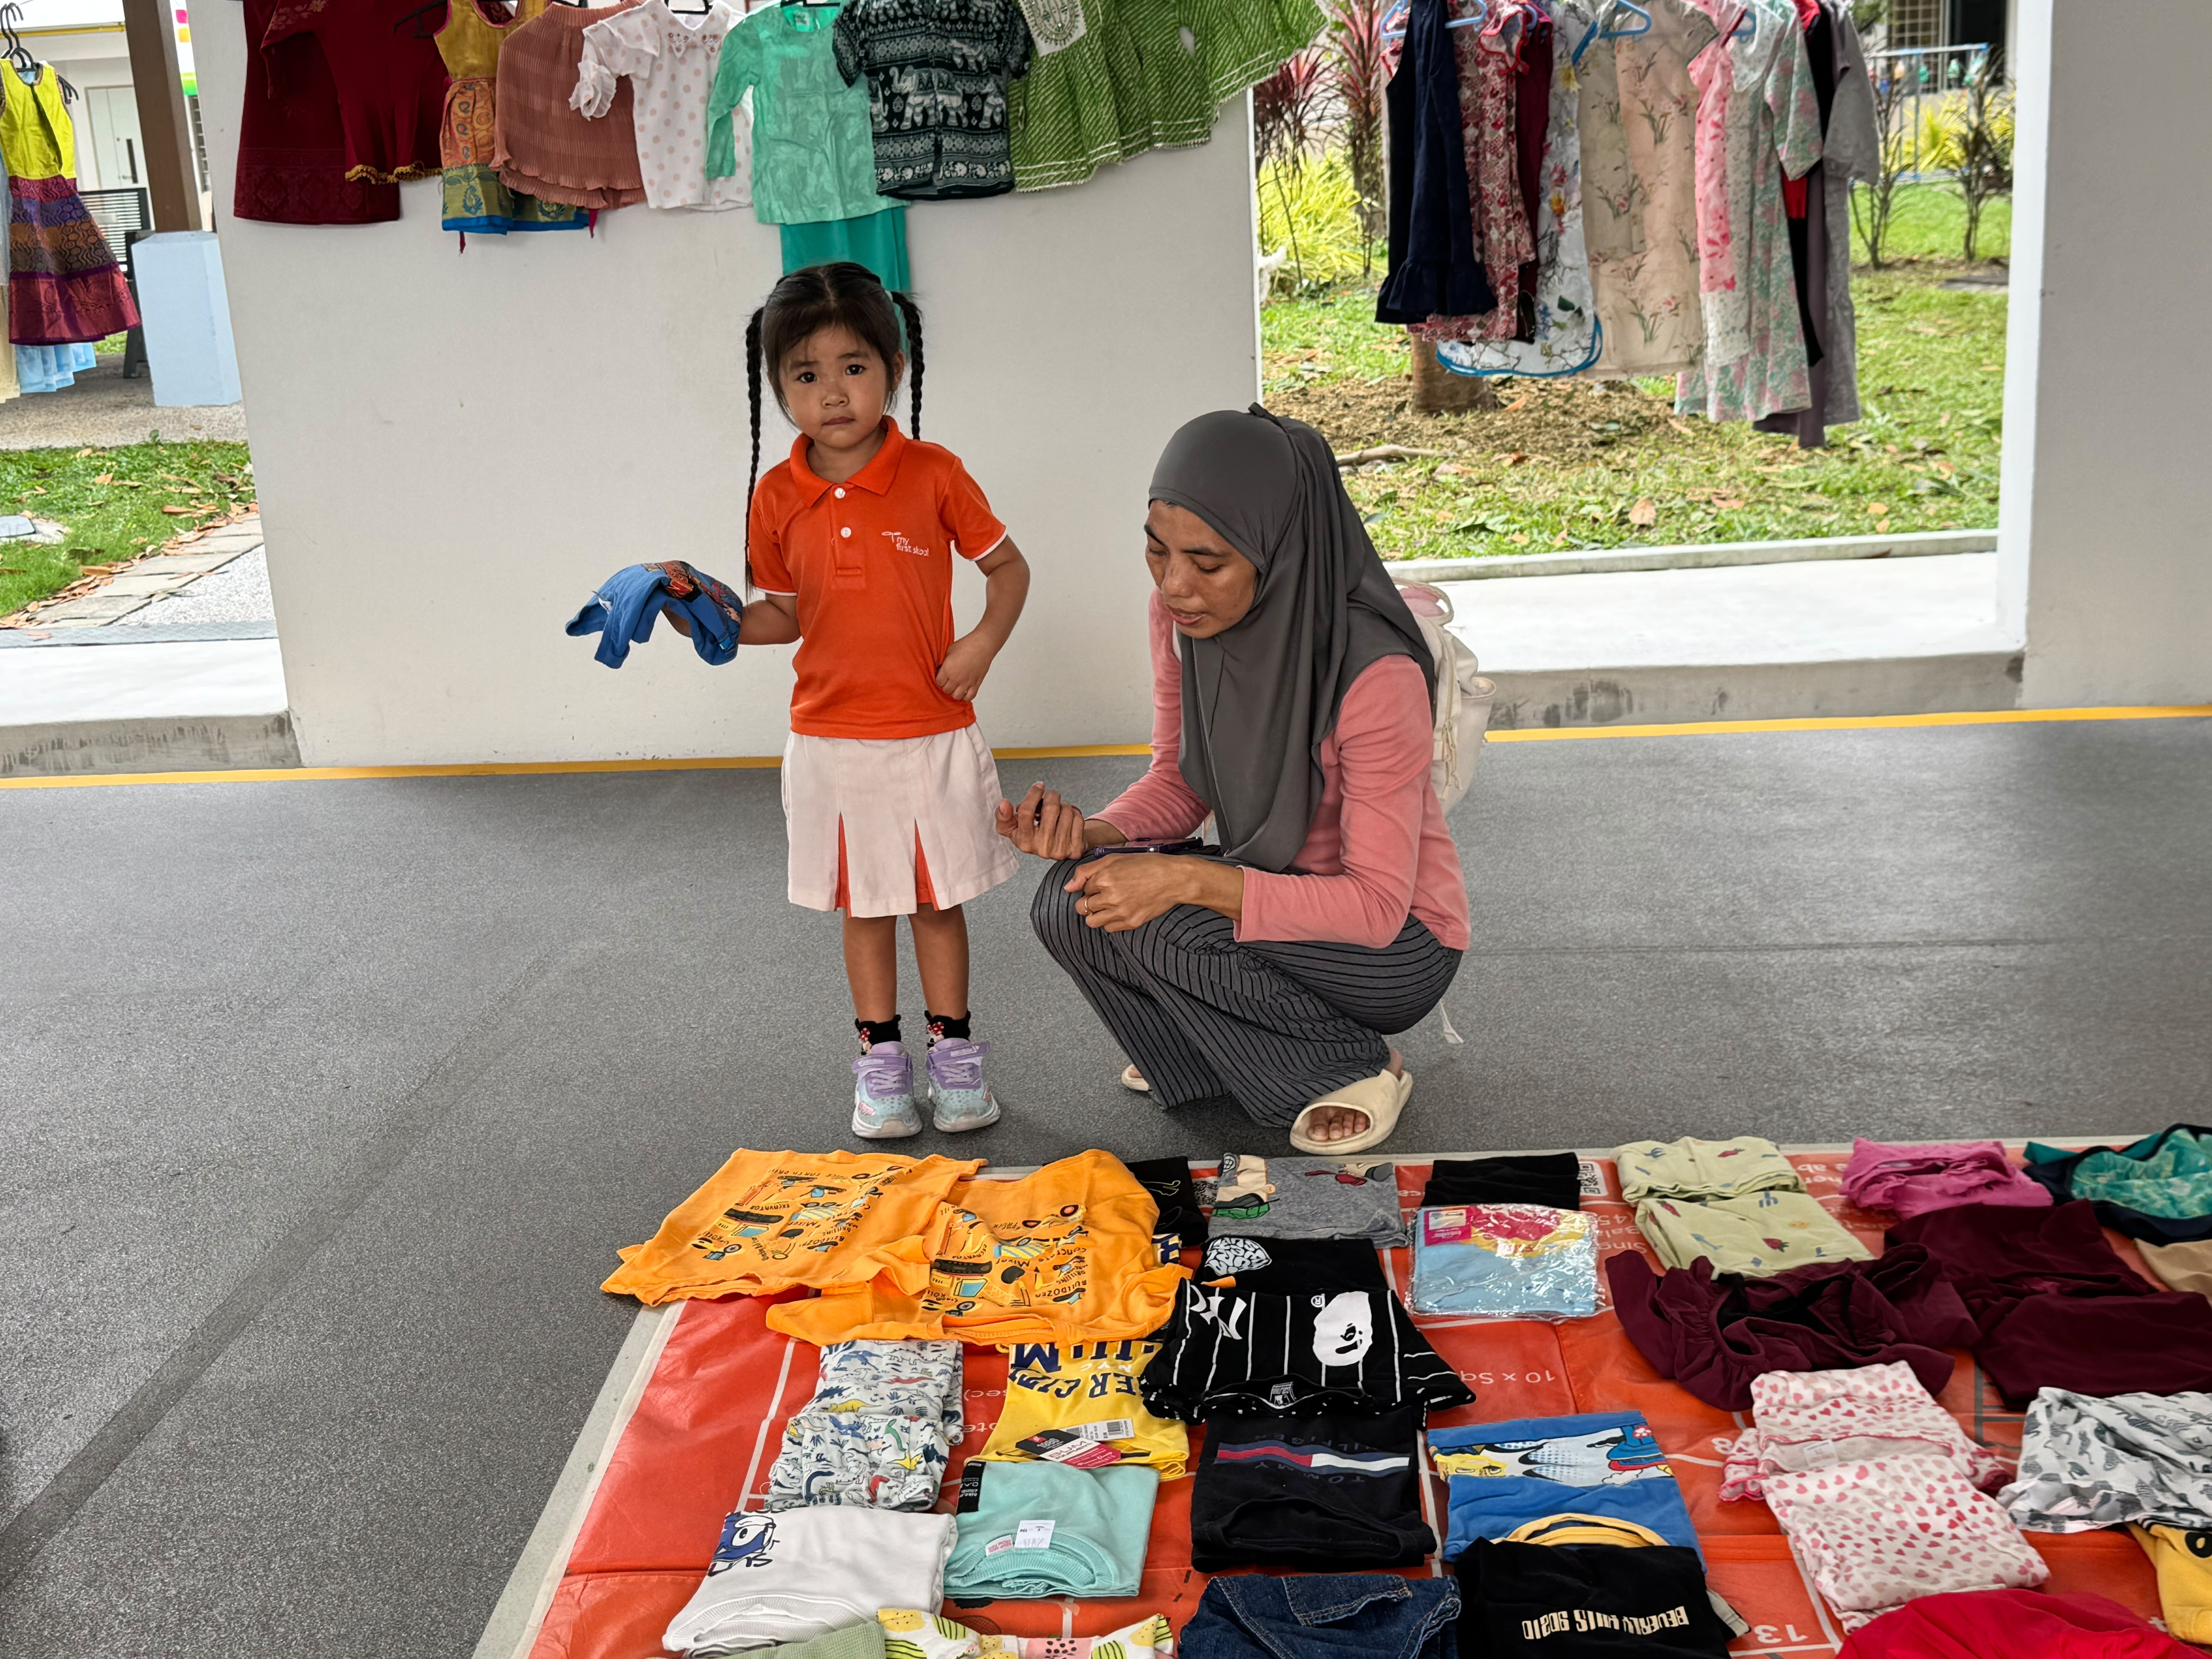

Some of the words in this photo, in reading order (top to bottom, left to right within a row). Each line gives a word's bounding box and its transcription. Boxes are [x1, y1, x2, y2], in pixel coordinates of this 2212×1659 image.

[896, 536, 909, 545] my
[896, 543, 912, 553] first
[1080, 1361, 1132, 1373] NYC
[1501, 1373, 1517, 1381] x
[1525, 1370, 1556, 1383] 10
[1711, 1437, 1733, 1455] 8
[1522, 1611, 1570, 1640] 90210
[1573, 1609, 1620, 1632] HILLS
[1622, 1606, 1690, 1635] BEVERLY
[1754, 1624, 1808, 1644] 13
